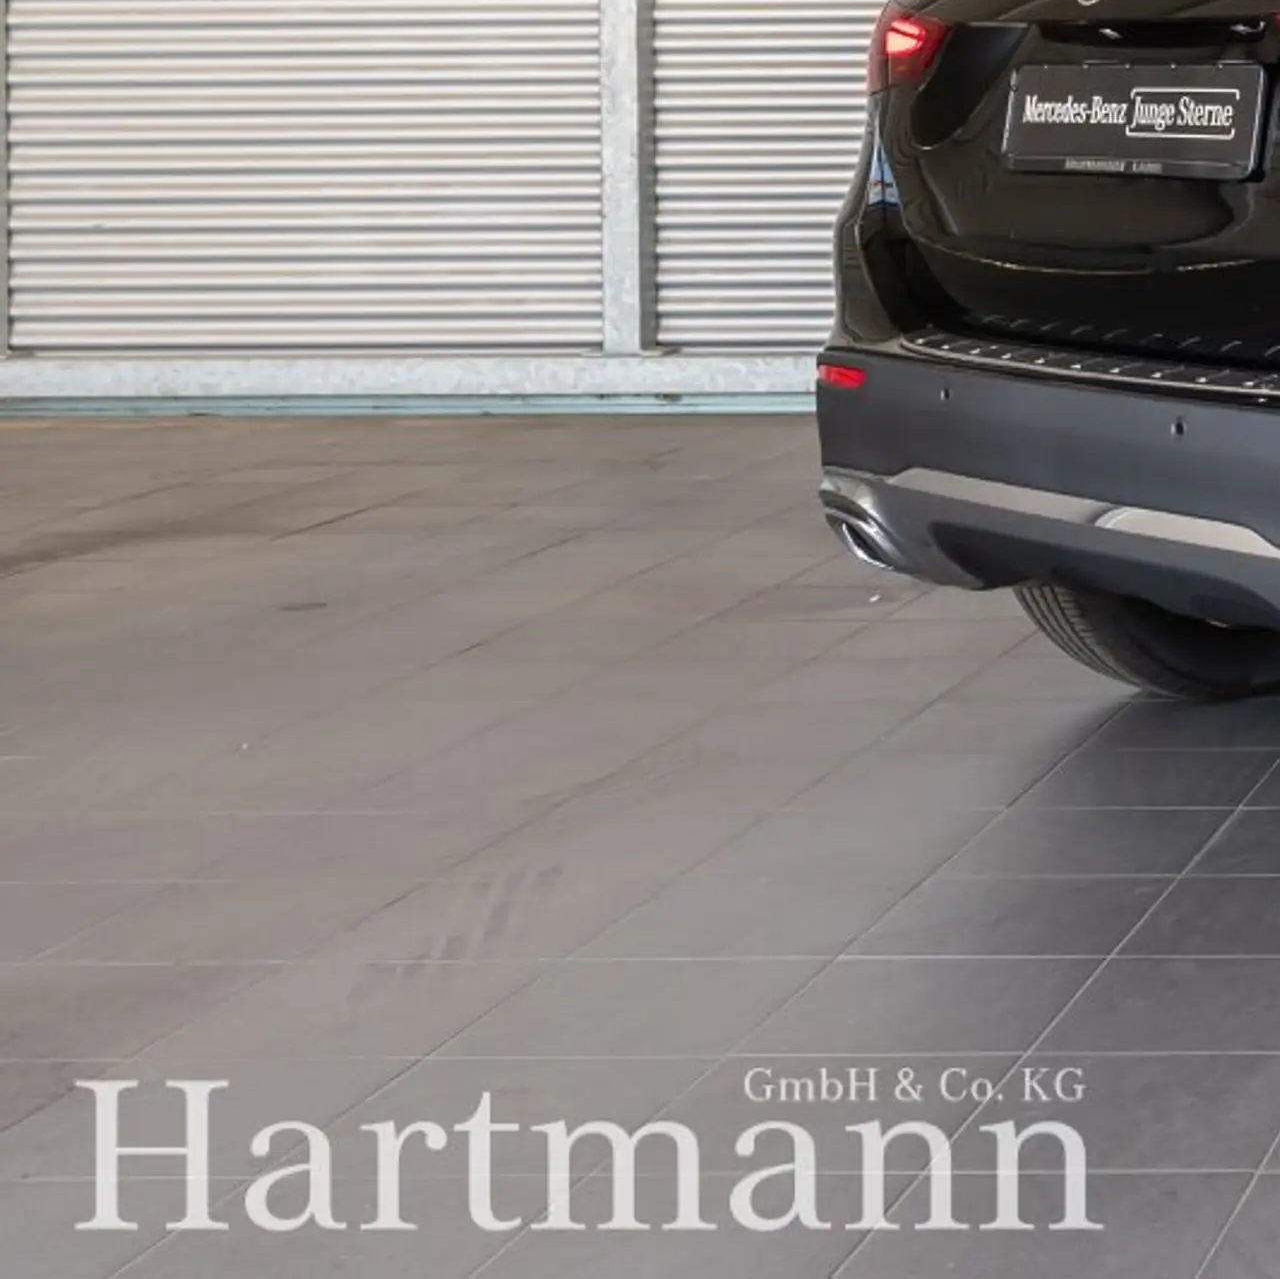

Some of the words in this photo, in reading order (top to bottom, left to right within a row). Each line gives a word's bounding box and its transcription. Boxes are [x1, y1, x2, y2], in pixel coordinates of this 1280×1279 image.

[1022, 94, 1129, 125] Mercedes-Benz
[1130, 95, 1175, 132] Junge
[1178, 96, 1234, 127] Sterne
